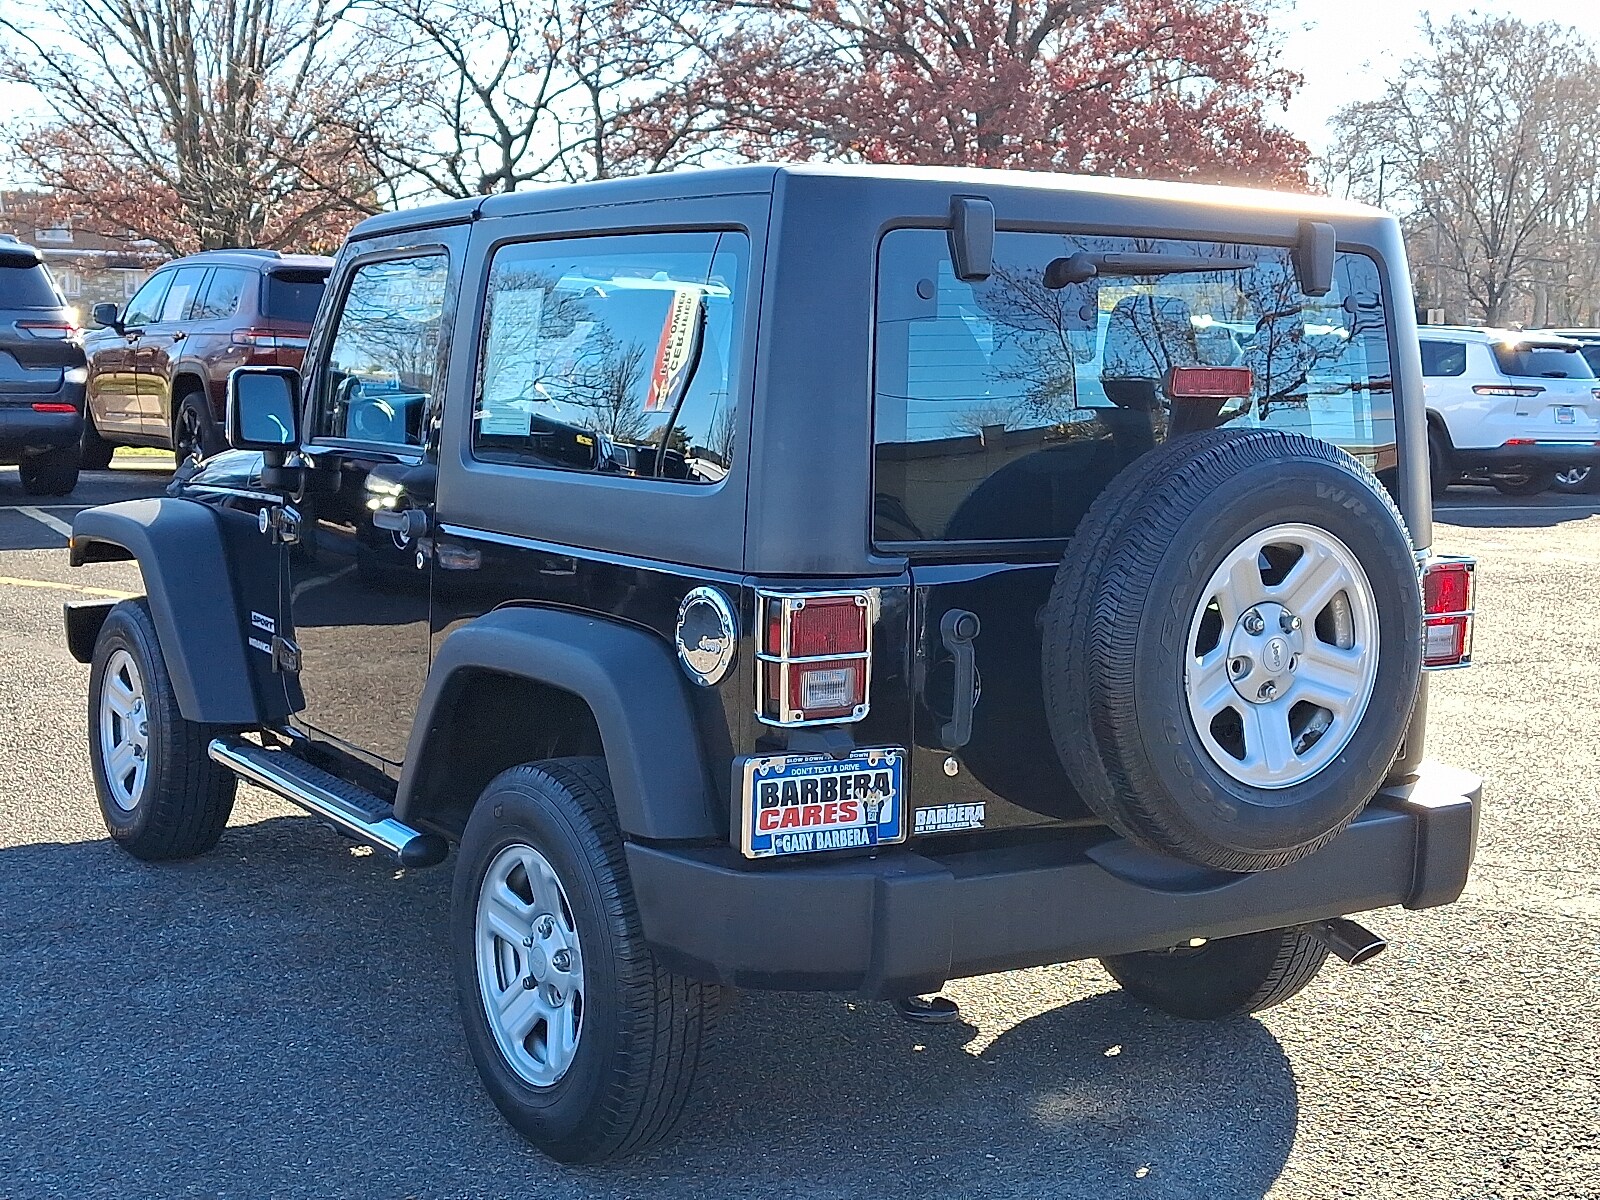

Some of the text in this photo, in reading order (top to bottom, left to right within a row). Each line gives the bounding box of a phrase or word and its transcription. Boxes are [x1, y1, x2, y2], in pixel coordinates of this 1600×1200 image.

[252, 614, 274, 629] SPORT
[699, 636, 721, 654] Jeep
[1271, 642, 1282, 668] Jeep
[791, 767, 813, 775] DON'T
[813, 765, 832, 774] TEXT
[839, 763, 860, 771] DRIVE
[760, 772, 891, 808] BARBERA
[759, 801, 859, 830] CARES
[915, 804, 985, 826] BARBERA
[782, 828, 870, 852] GARY BARBERA
